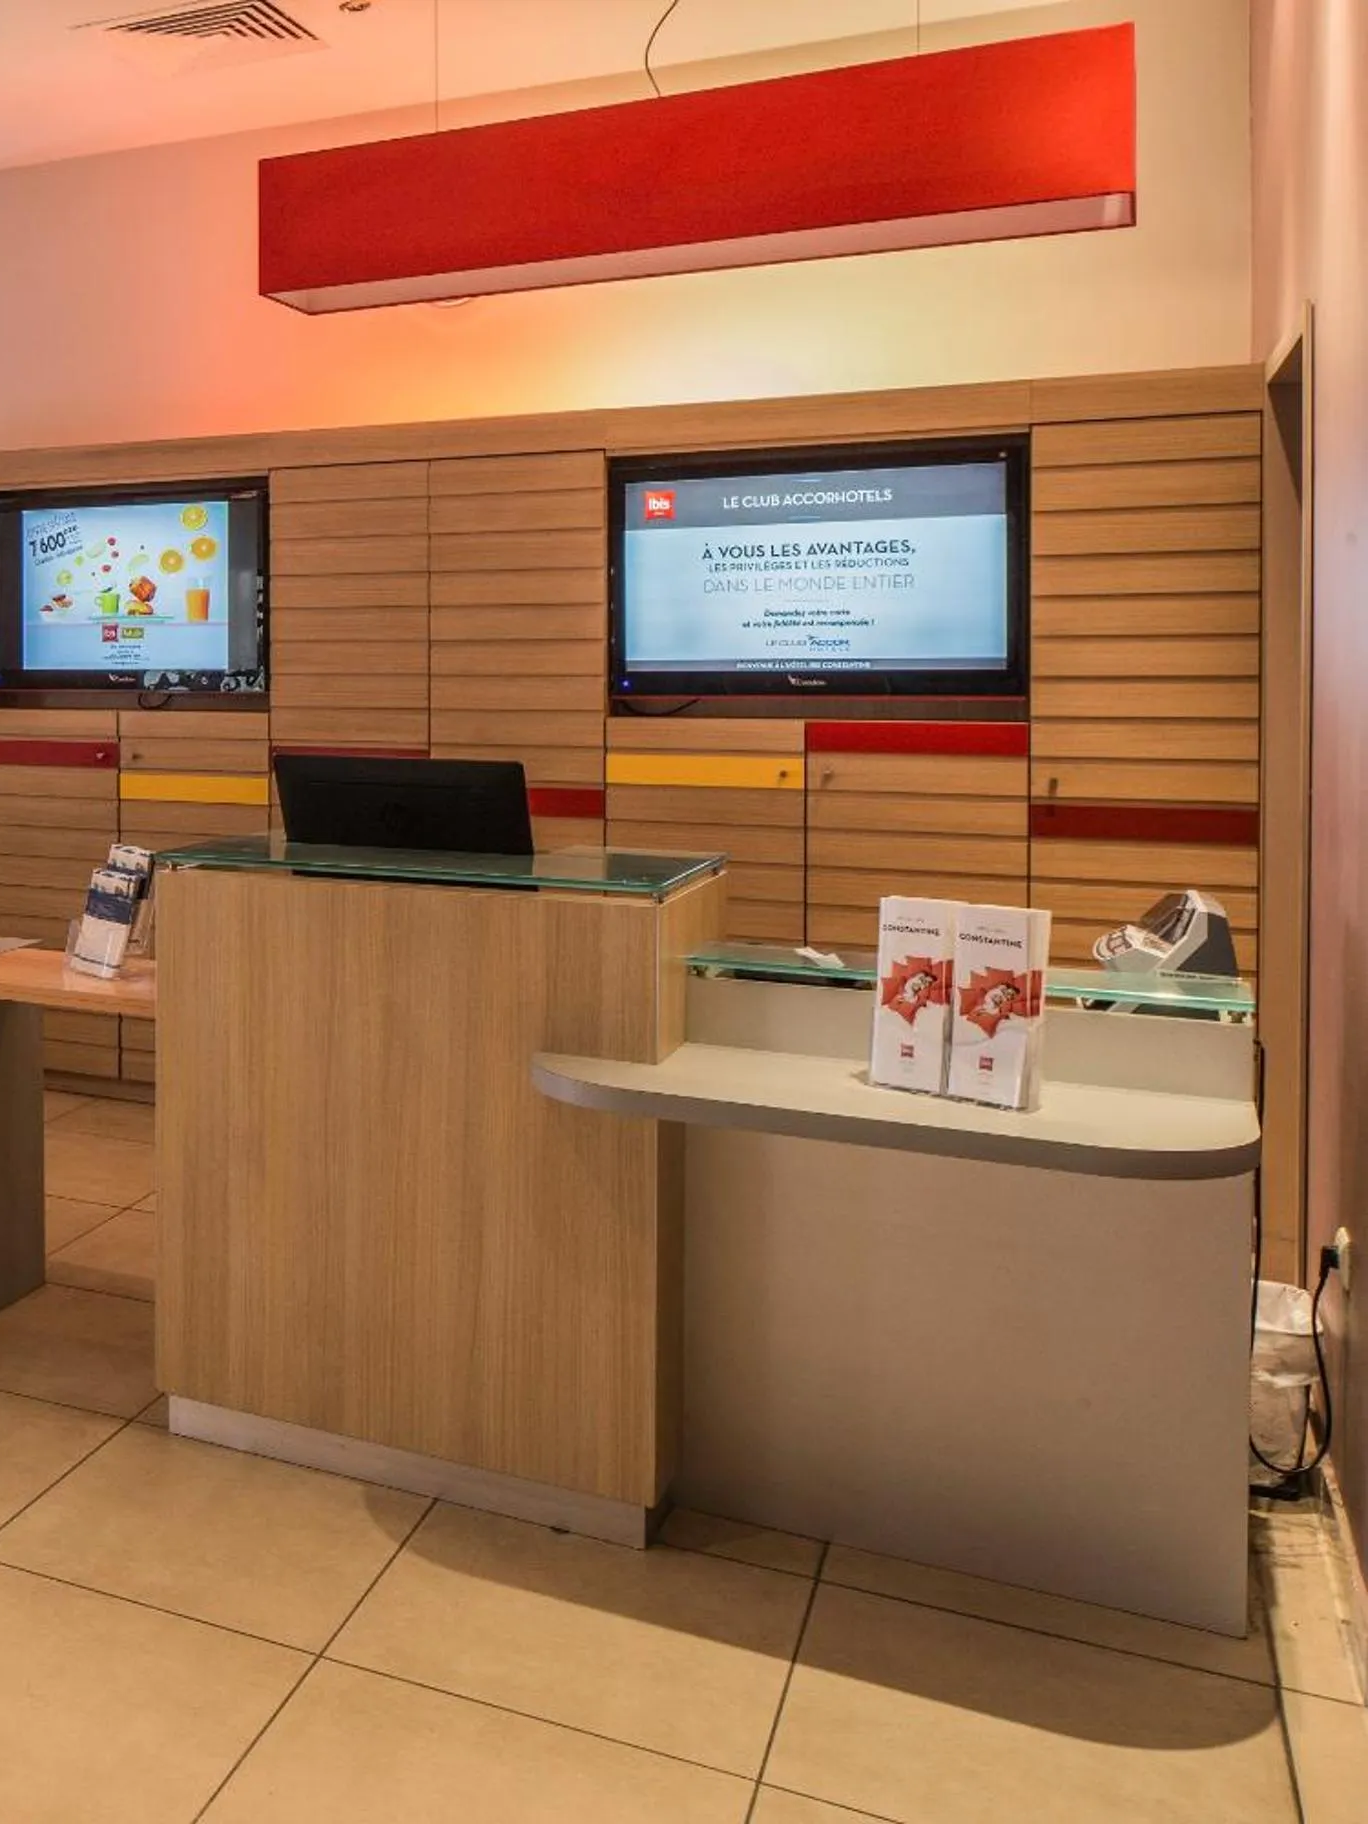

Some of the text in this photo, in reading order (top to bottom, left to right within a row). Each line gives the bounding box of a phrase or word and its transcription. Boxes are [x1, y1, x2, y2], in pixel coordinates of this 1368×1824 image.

[723, 488, 894, 510] LE CLUB ACCORHOTELS
[718, 544, 766, 559] VOUS
[770, 543, 801, 557] LES
[806, 539, 917, 556] AVANTAGES,
[709, 562, 728, 573] LES
[811, 559, 831, 571] LES
[835, 556, 910, 569] RÉDUCTIONS
[703, 573, 915, 594] DANS LE MONDE ENTIER
[882, 924, 941, 937] CONSTANTINE
[958, 933, 1023, 949] CONSTANTINE
